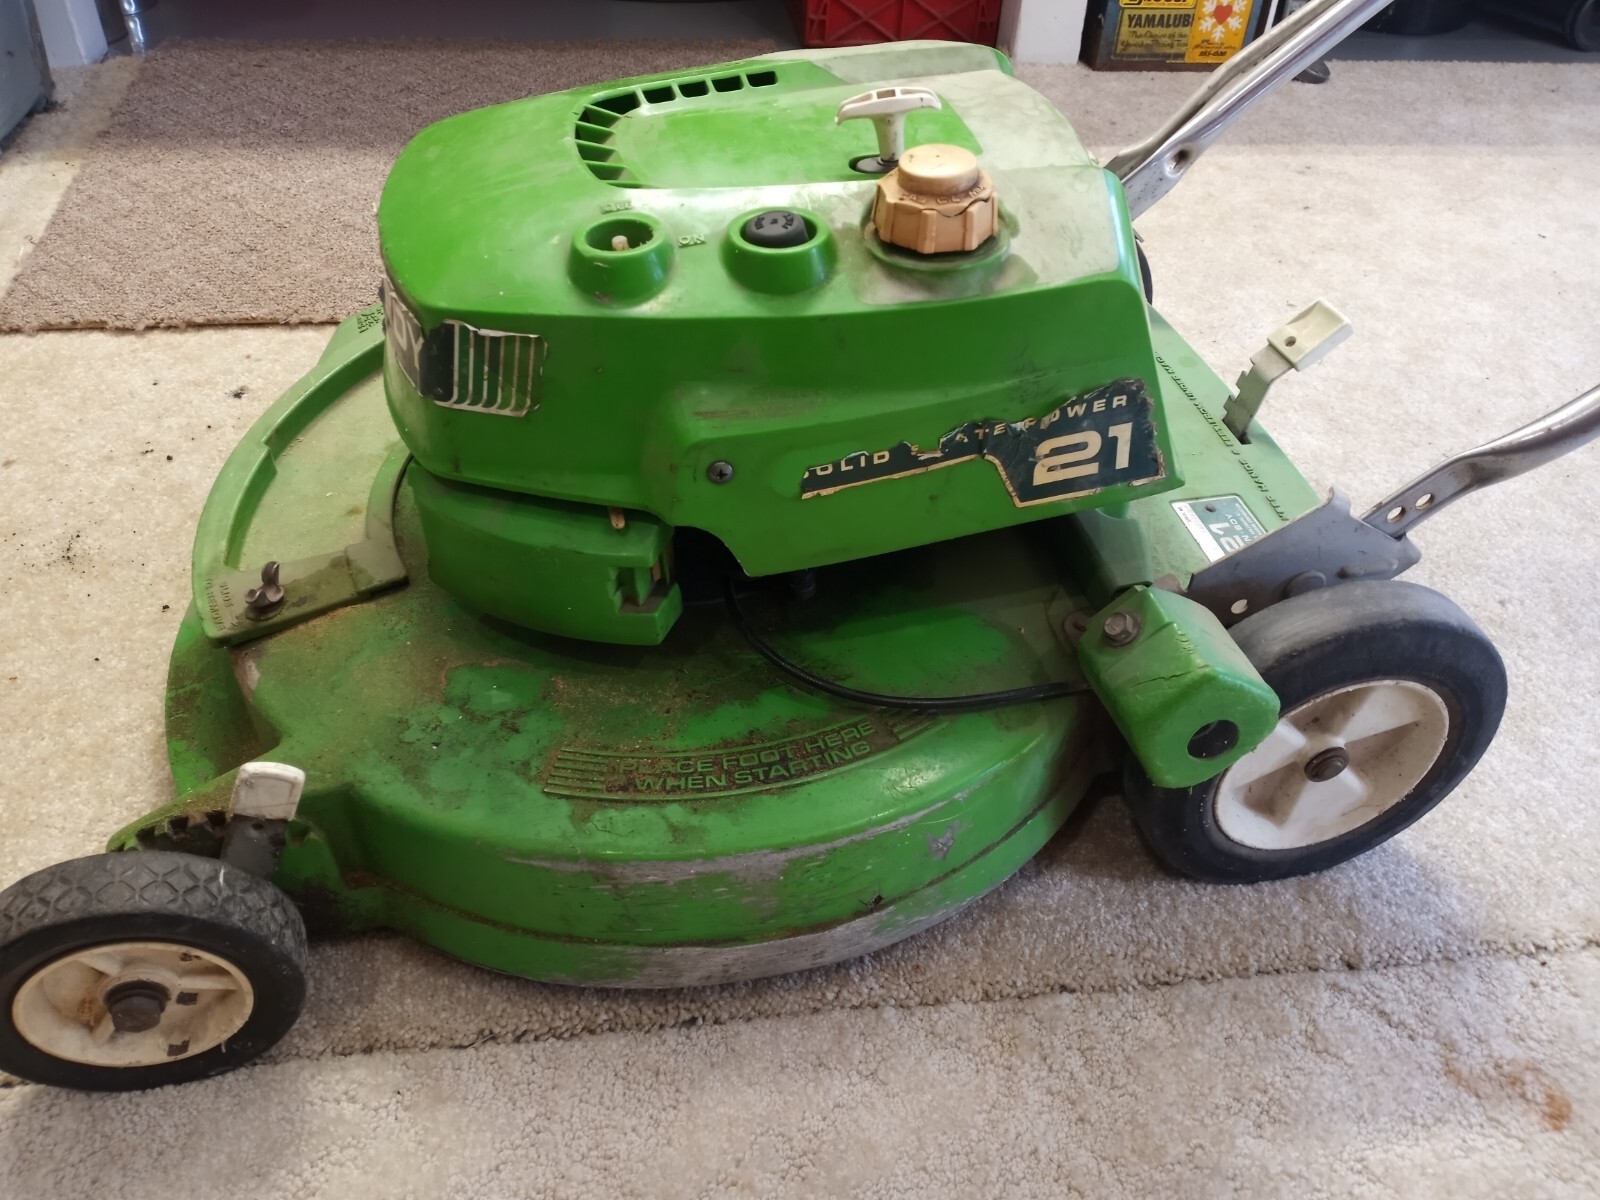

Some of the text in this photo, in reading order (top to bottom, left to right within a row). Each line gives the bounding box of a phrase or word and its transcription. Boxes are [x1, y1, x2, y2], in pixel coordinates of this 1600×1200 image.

[679, 233, 706, 248] ON
[1032, 421, 1133, 486] 21
[619, 721, 874, 774] PLACE FOOT HERE
[634, 740, 871, 792] WHEN STARTING
